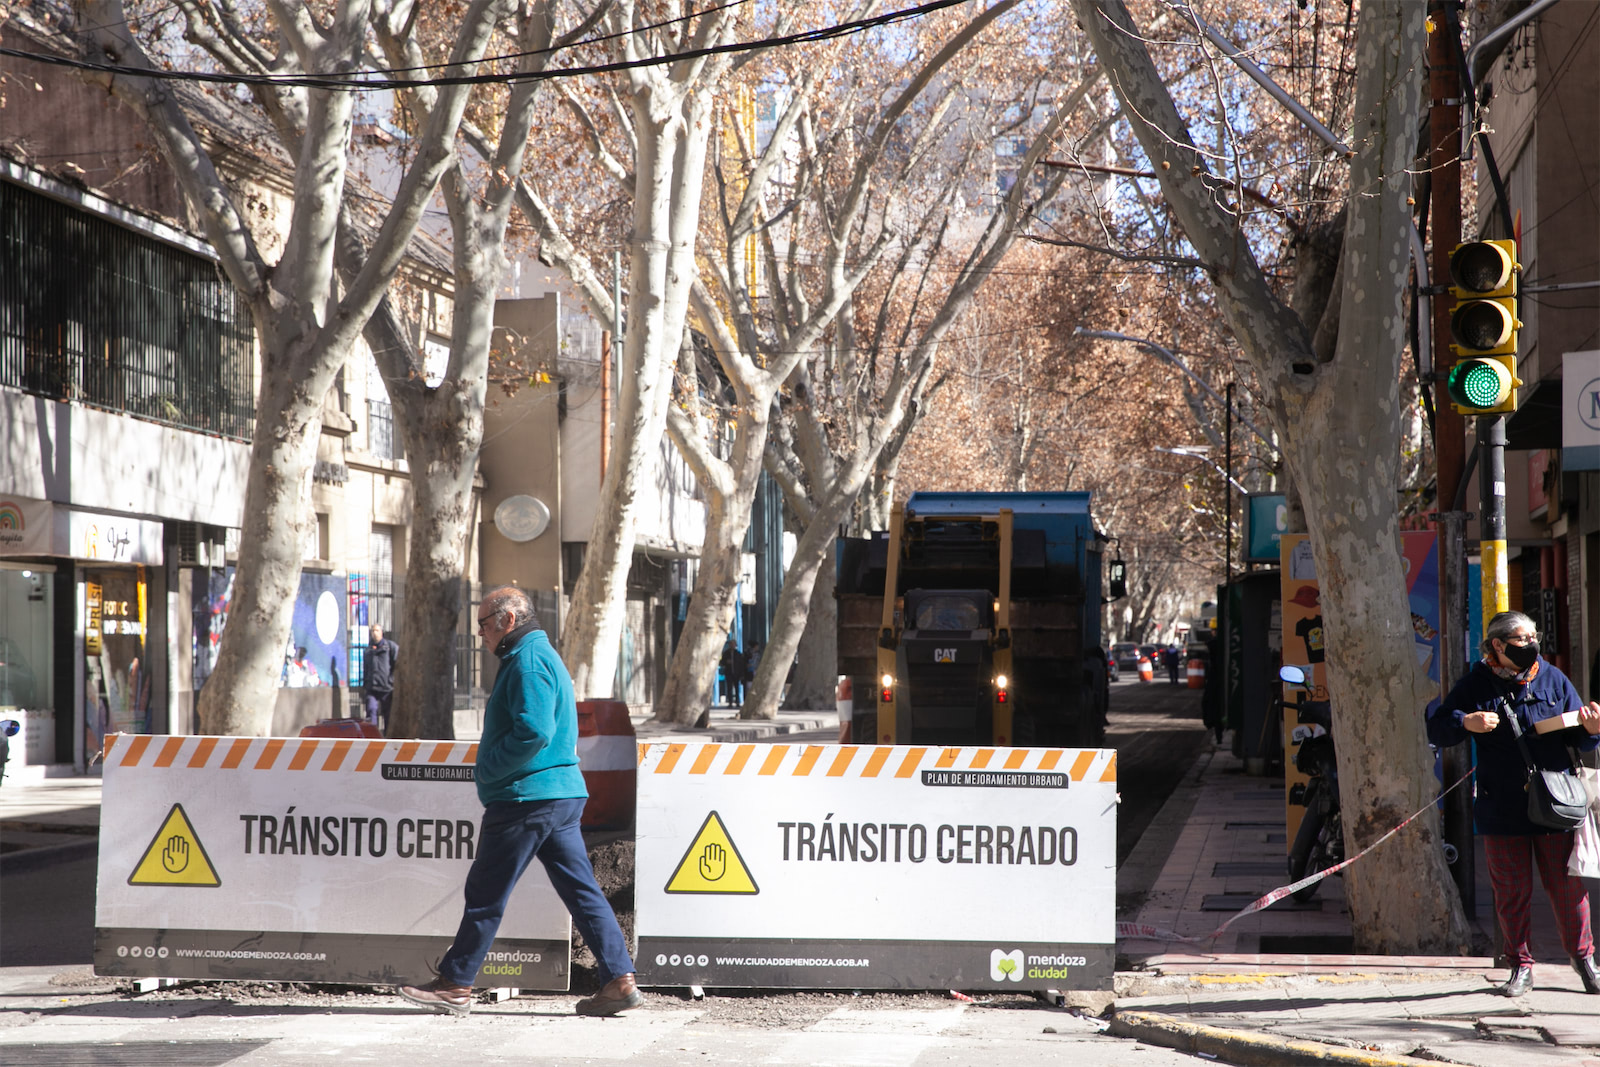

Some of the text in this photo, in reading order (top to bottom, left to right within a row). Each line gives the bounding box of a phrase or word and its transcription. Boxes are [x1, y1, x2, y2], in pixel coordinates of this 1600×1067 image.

[1543, 591, 1554, 653] OPTICA
[934, 648, 957, 663] CAT
[387, 767, 408, 778] PLAN
[411, 767, 421, 778] DE
[927, 772, 1063, 786] PLAN DE MEJORAMIENTO URBANO
[239, 806, 478, 860] TRÁNSITO CERR
[777, 812, 1078, 866] TRÁNSITO CERRADO
[175, 949, 326, 961] WWW.CIUDADDEMENDOZA.GOB.AR
[484, 950, 541, 963] mendoza
[1028, 953, 1086, 966] mendoza
[715, 957, 869, 967] WWW.CIUDADDEMENDOZA.GOB.AR
[483, 963, 522, 976] ciudad
[1028, 966, 1068, 979] ciudad
